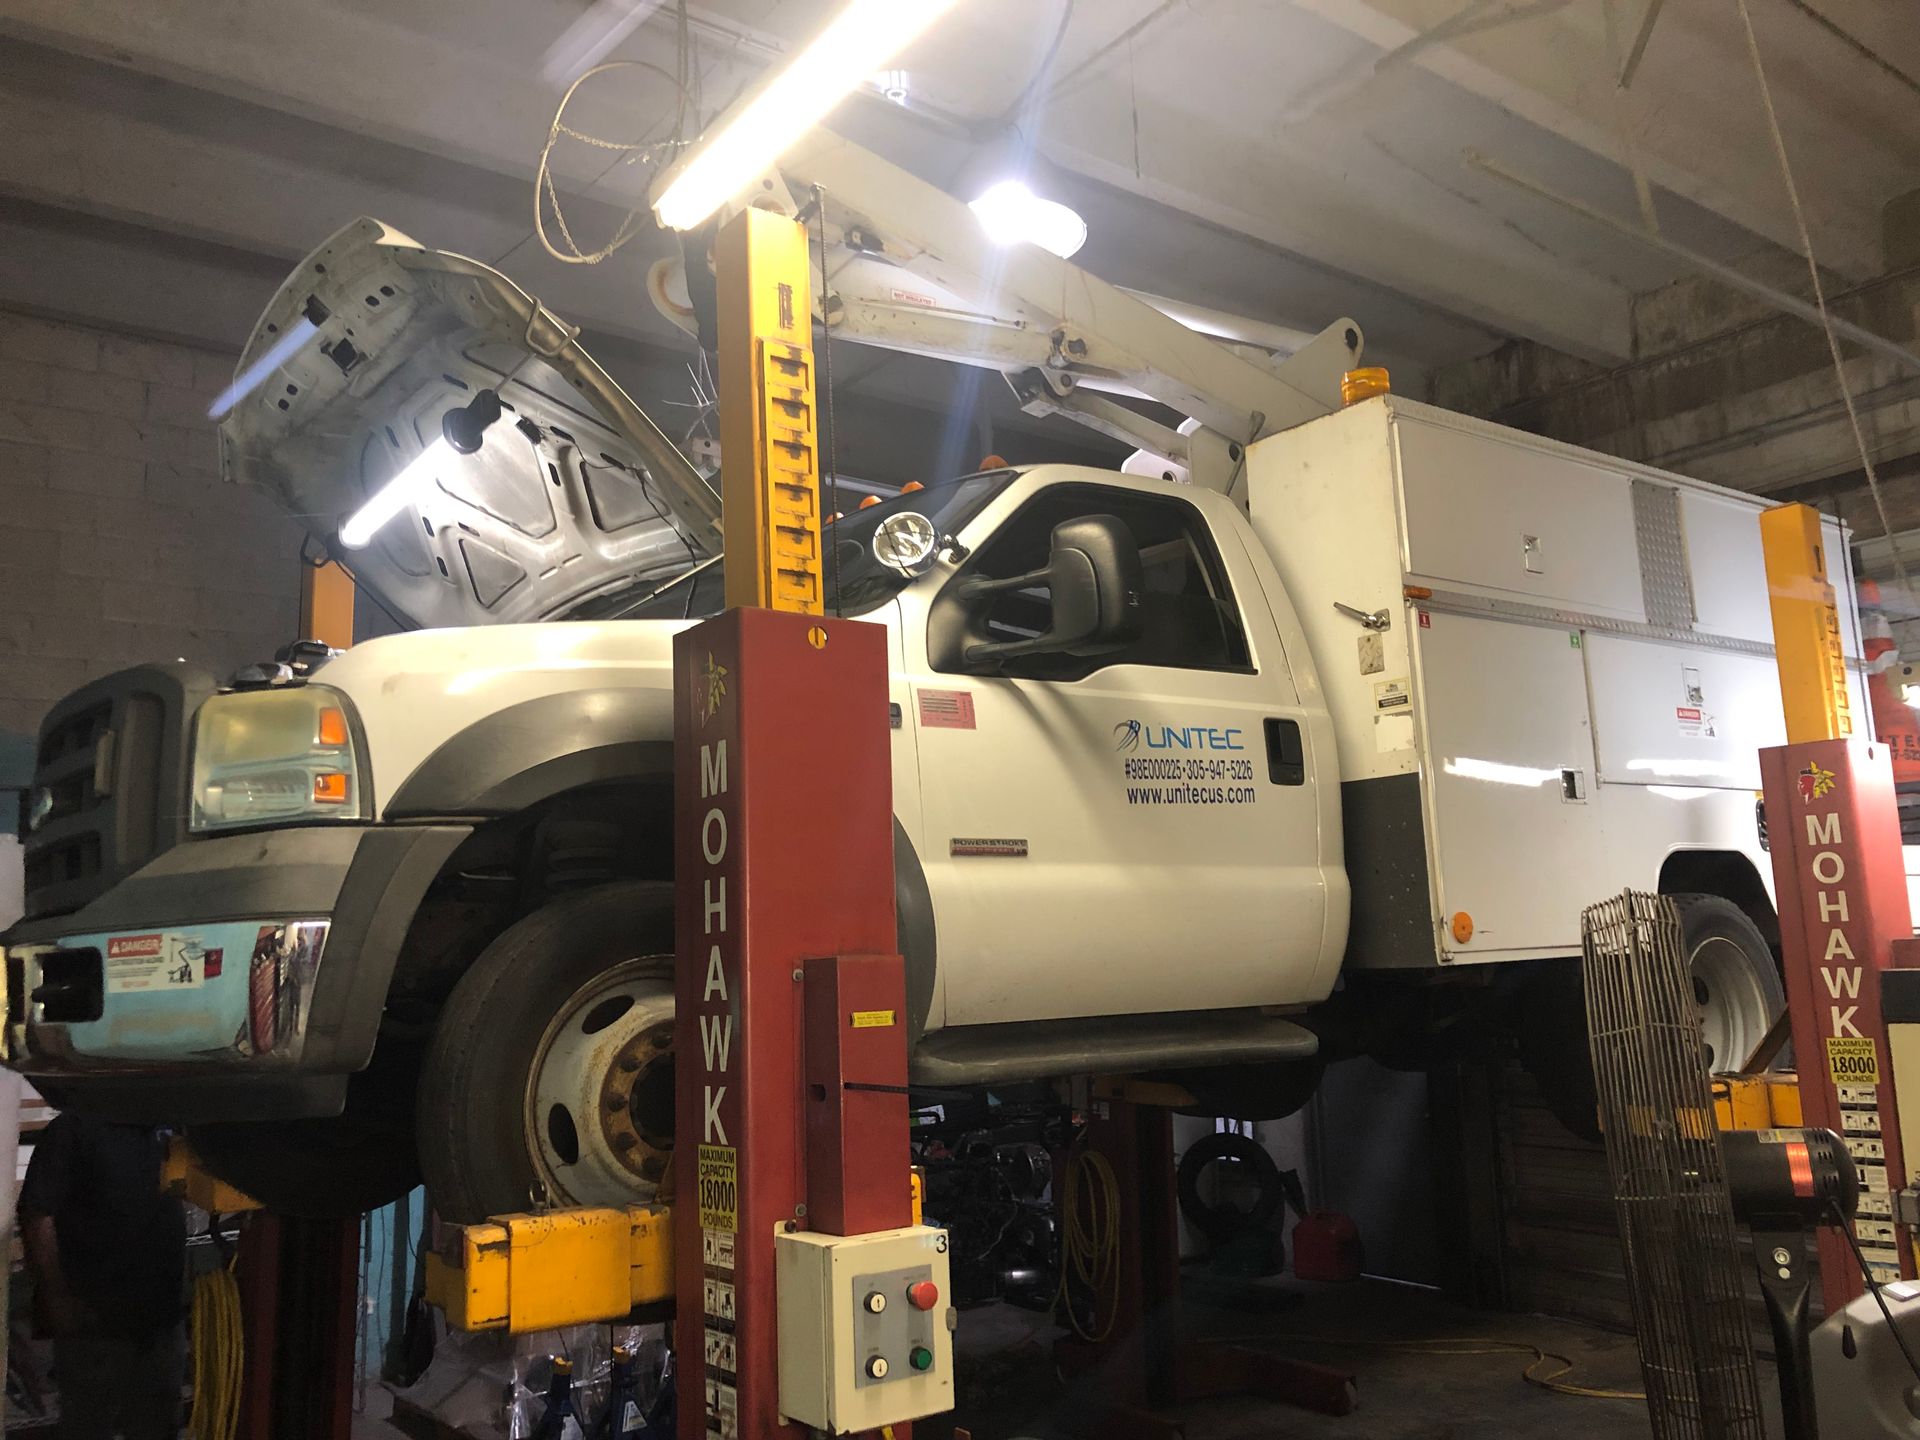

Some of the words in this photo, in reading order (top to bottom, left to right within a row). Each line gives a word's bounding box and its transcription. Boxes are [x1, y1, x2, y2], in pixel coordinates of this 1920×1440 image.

[1145, 726, 1244, 750] UNITEC
[1127, 783, 1256, 804] www.unitecus.com
[1806, 813, 1864, 1037] MOHAWK
[700, 739, 733, 1146] MOHAWK
[1828, 1039, 1872, 1048] MAXIMUM
[1830, 1047, 1872, 1056] CAPACITY
[1831, 1056, 1876, 1074] 18000
[1837, 1074, 1874, 1083] POUNDS
[699, 1148, 735, 1165] MAXIMUM
[699, 1162, 735, 1179] CAPACITY
[699, 1178, 736, 1214] 18000
[703, 1213, 734, 1230] POUNDS
[936, 1234, 947, 1253] 3
